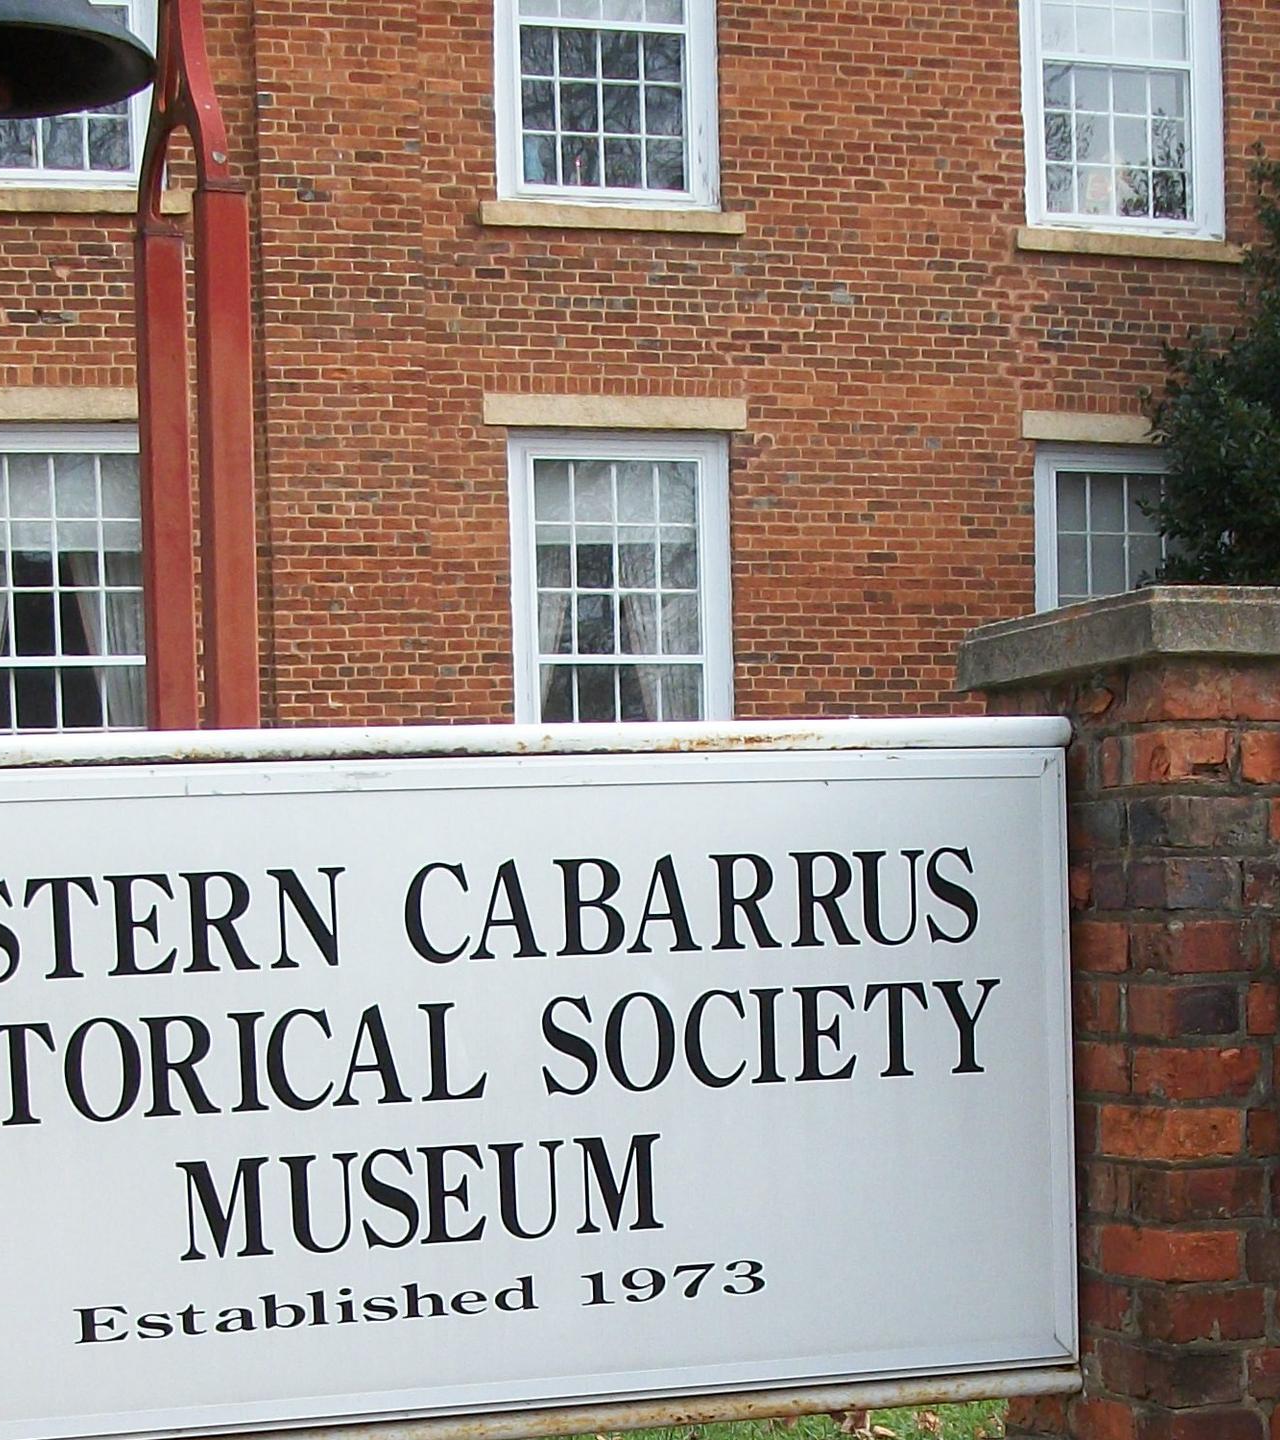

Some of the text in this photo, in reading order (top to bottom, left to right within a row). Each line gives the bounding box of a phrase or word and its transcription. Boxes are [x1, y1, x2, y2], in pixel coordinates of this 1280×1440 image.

[404, 846, 980, 965] CABARRUS
[541, 978, 1001, 1097] SOCIETY
[175, 1133, 664, 1261] MUSEUM
[73, 1260, 765, 1344] Established 1973
